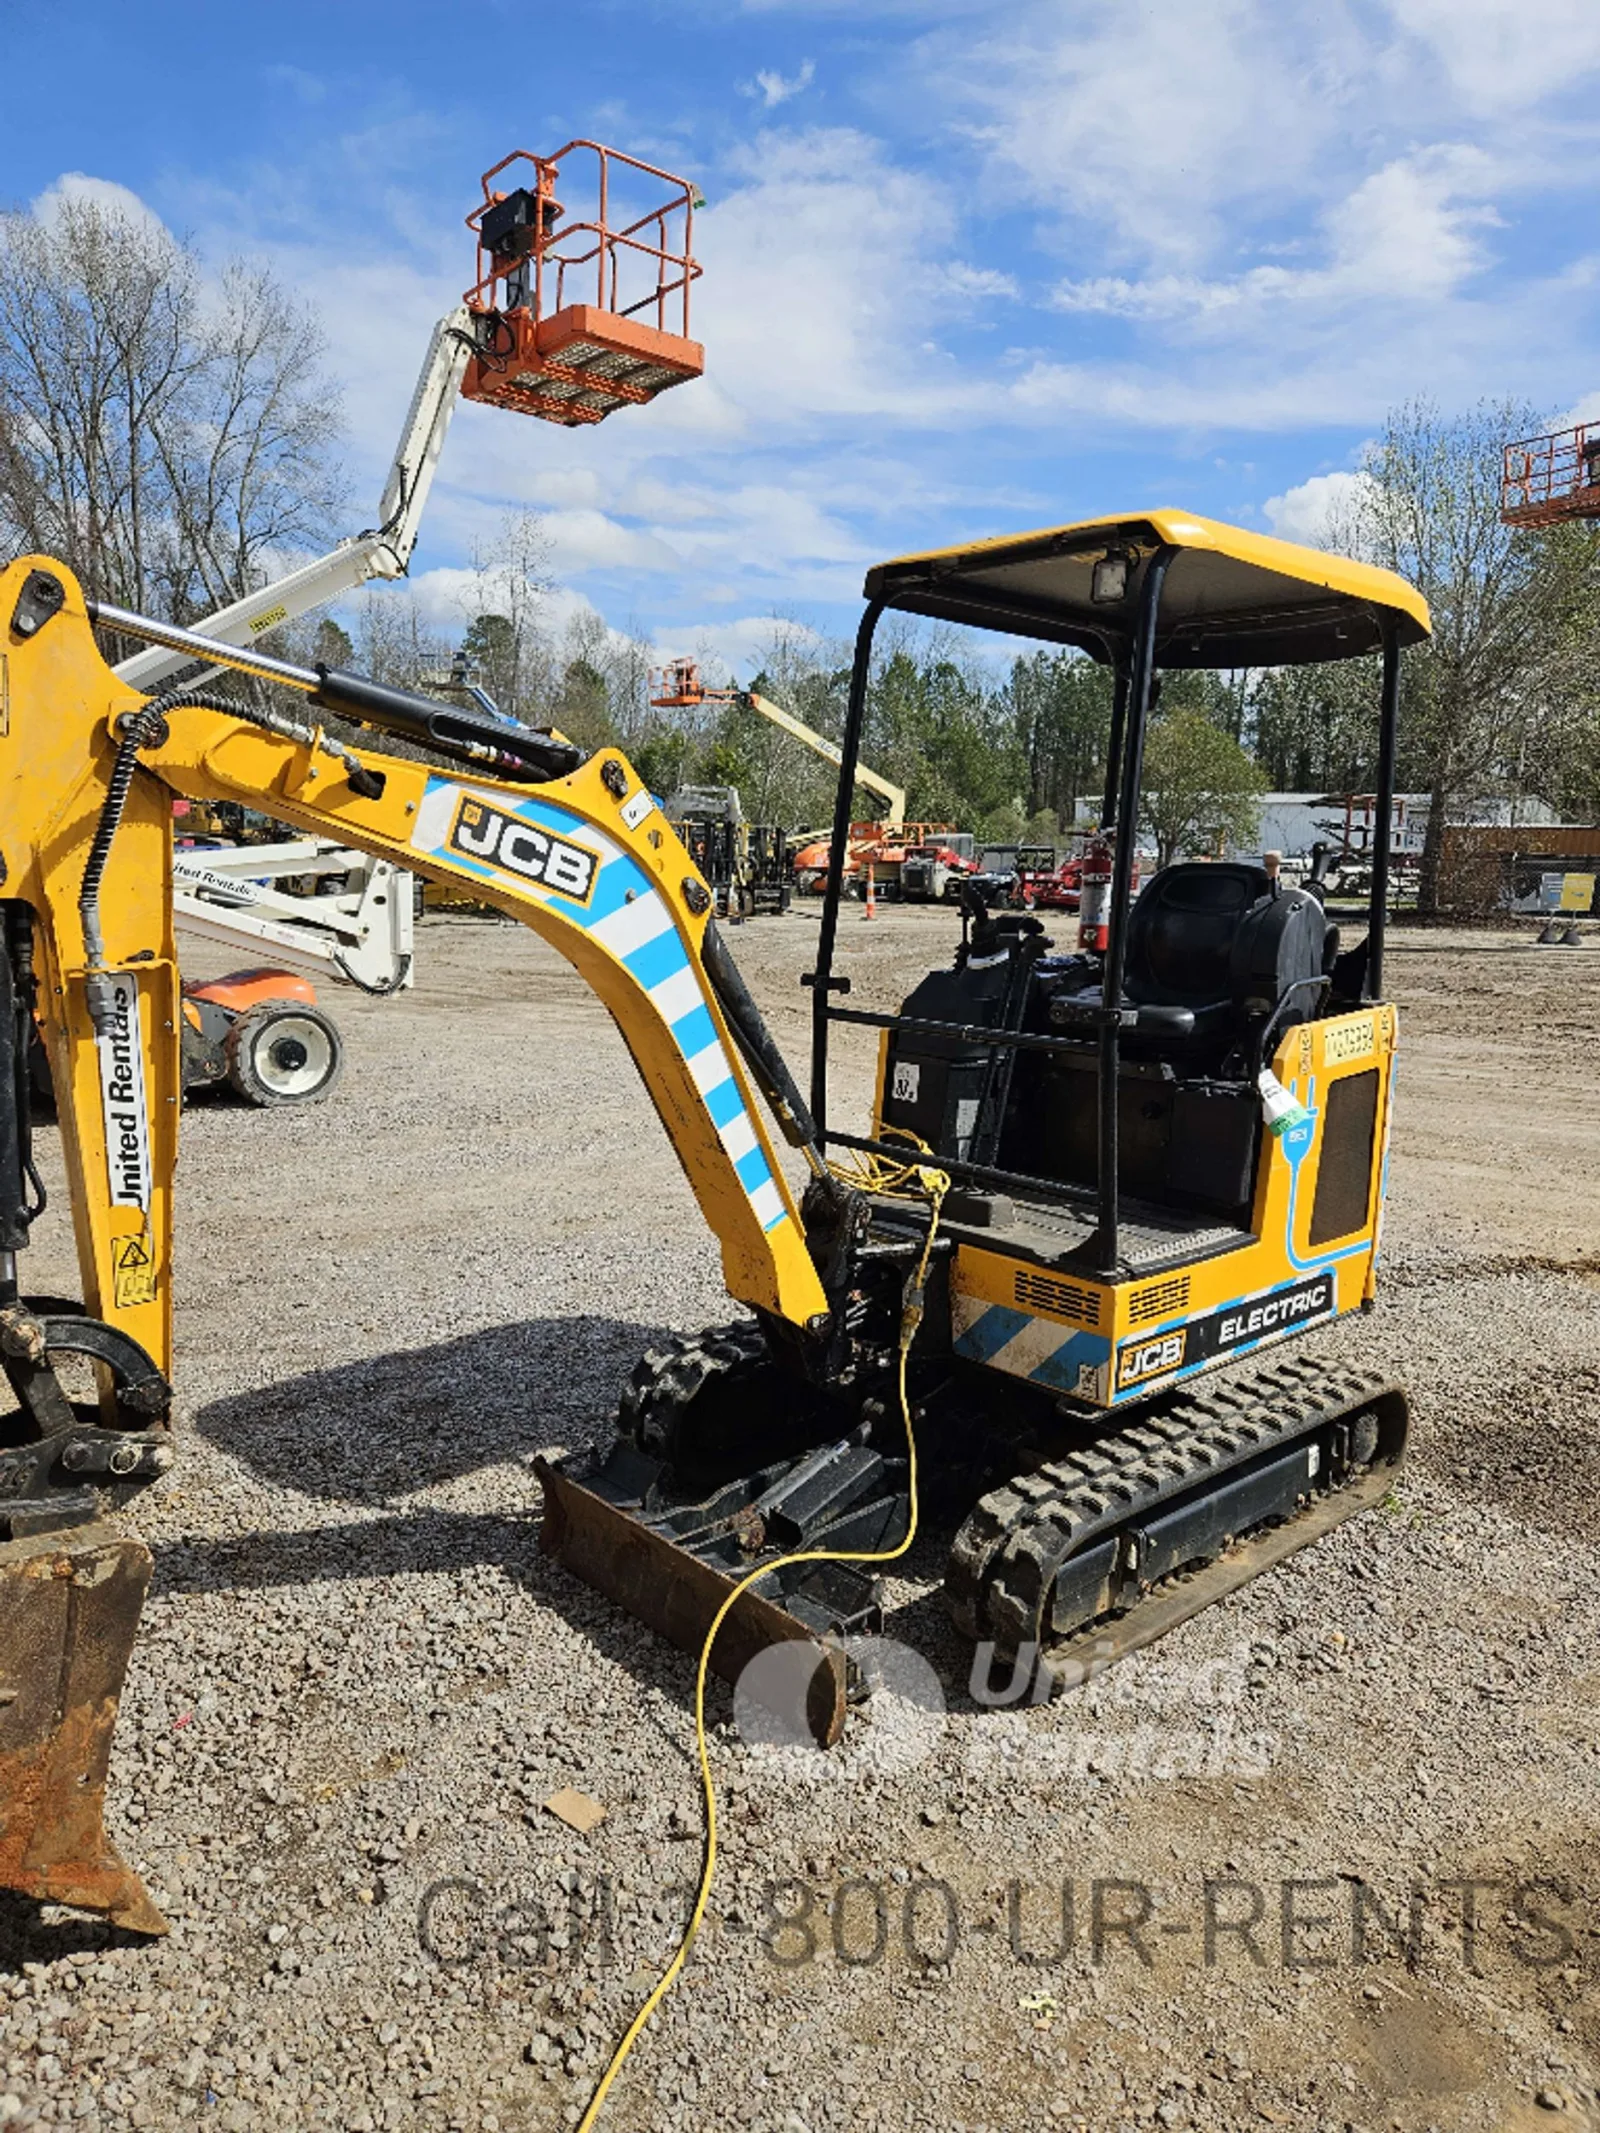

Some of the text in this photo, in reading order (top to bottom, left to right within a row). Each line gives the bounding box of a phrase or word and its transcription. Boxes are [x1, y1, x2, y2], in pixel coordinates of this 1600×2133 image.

[458, 813, 591, 895] JCB
[1122, 1285, 1327, 1379] JCB ELECTRIC
